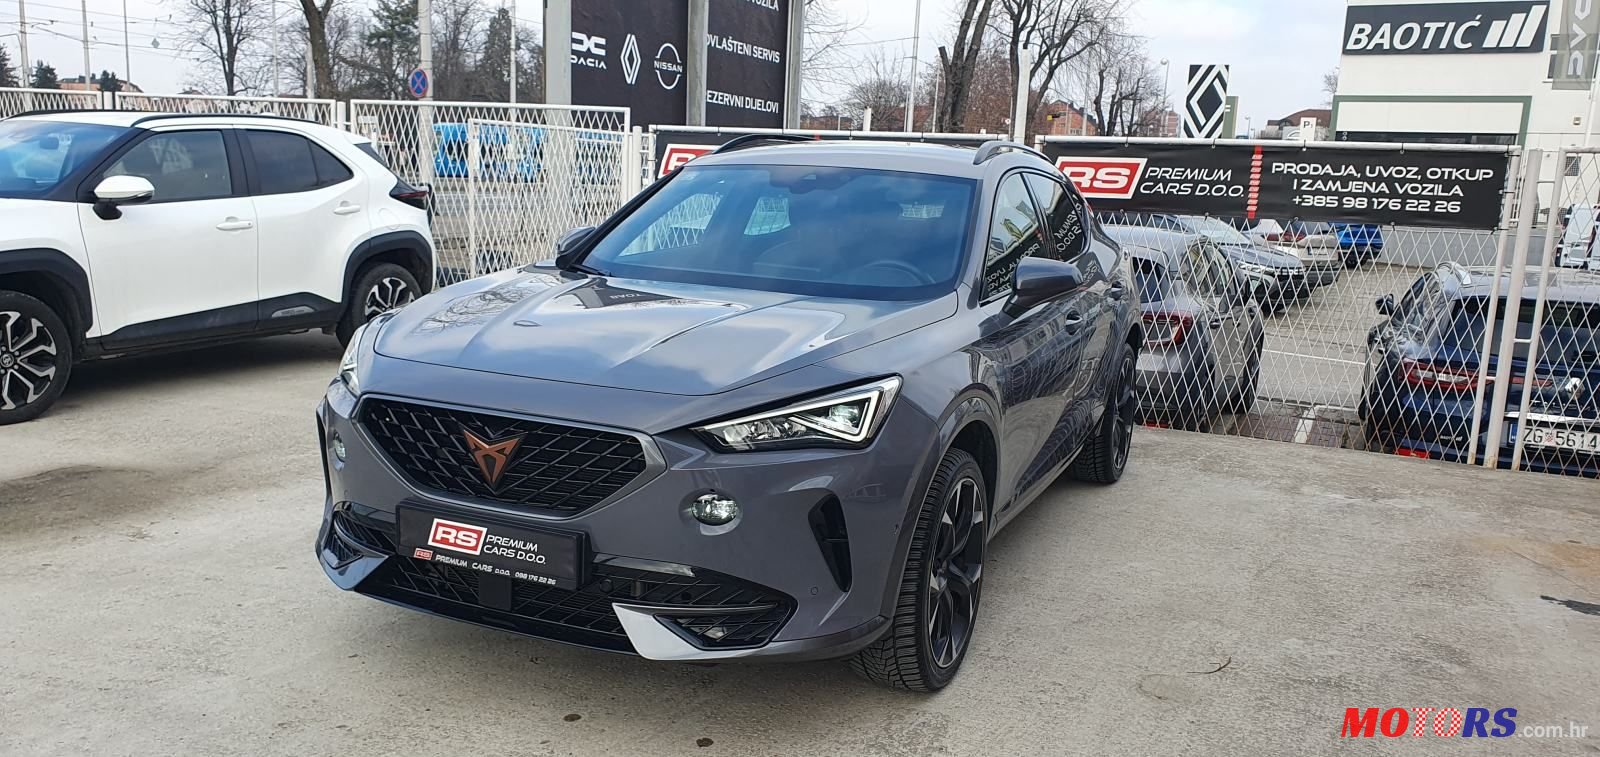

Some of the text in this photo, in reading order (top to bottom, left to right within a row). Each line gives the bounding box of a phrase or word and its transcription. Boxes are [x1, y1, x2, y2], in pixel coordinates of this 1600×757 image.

[1346, 14, 1482, 50] BAOTIĆ
[753, 46, 780, 64] SERVIS
[654, 61, 683, 73] NISSAN
[707, 90, 779, 114] EZERVNI DIJELOVI
[1062, 166, 1131, 189] RS
[1145, 167, 1232, 181] PREMIUM
[1271, 162, 1494, 181] PRODAJA, UVOZ, OTKUP
[1140, 182, 1245, 198] CARS D.O.O.
[1293, 178, 1464, 197] I ZAMJENA VOZILA
[1292, 194, 1461, 213] +385 98 176 22 26
[1523, 427, 1544, 443] ZG
[1556, 431, 1598, 449] 5614
[435, 525, 478, 547] RS
[486, 534, 538, 552] PREMIUM
[484, 545, 546, 565] CARS D.O.O.
[435, 554, 468, 568] PREMIUM
[472, 562, 493, 572] CARS
[528, 573, 538, 582] 176
